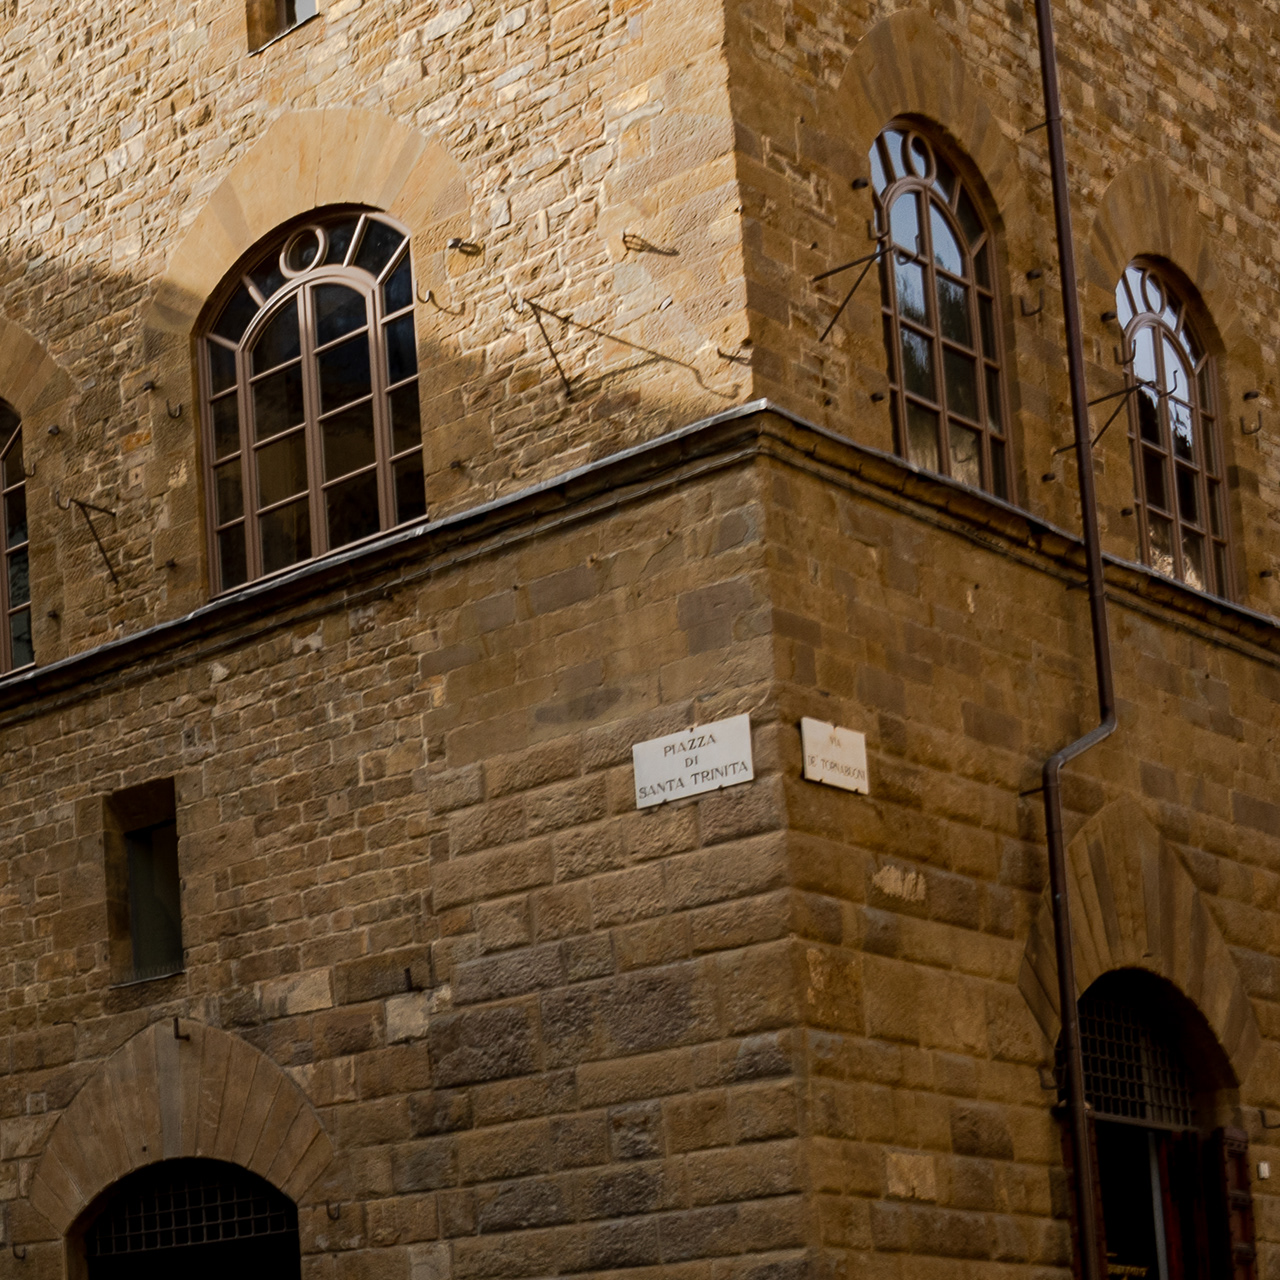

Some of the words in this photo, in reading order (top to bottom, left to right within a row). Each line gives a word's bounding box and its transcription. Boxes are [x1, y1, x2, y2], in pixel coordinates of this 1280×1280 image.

[663, 734, 716, 757] PIAZZA
[829, 735, 842, 748] VIA
[685, 755, 699, 768] DI
[638, 777, 685, 799] SANTA
[690, 760, 749, 785] TRINITA
